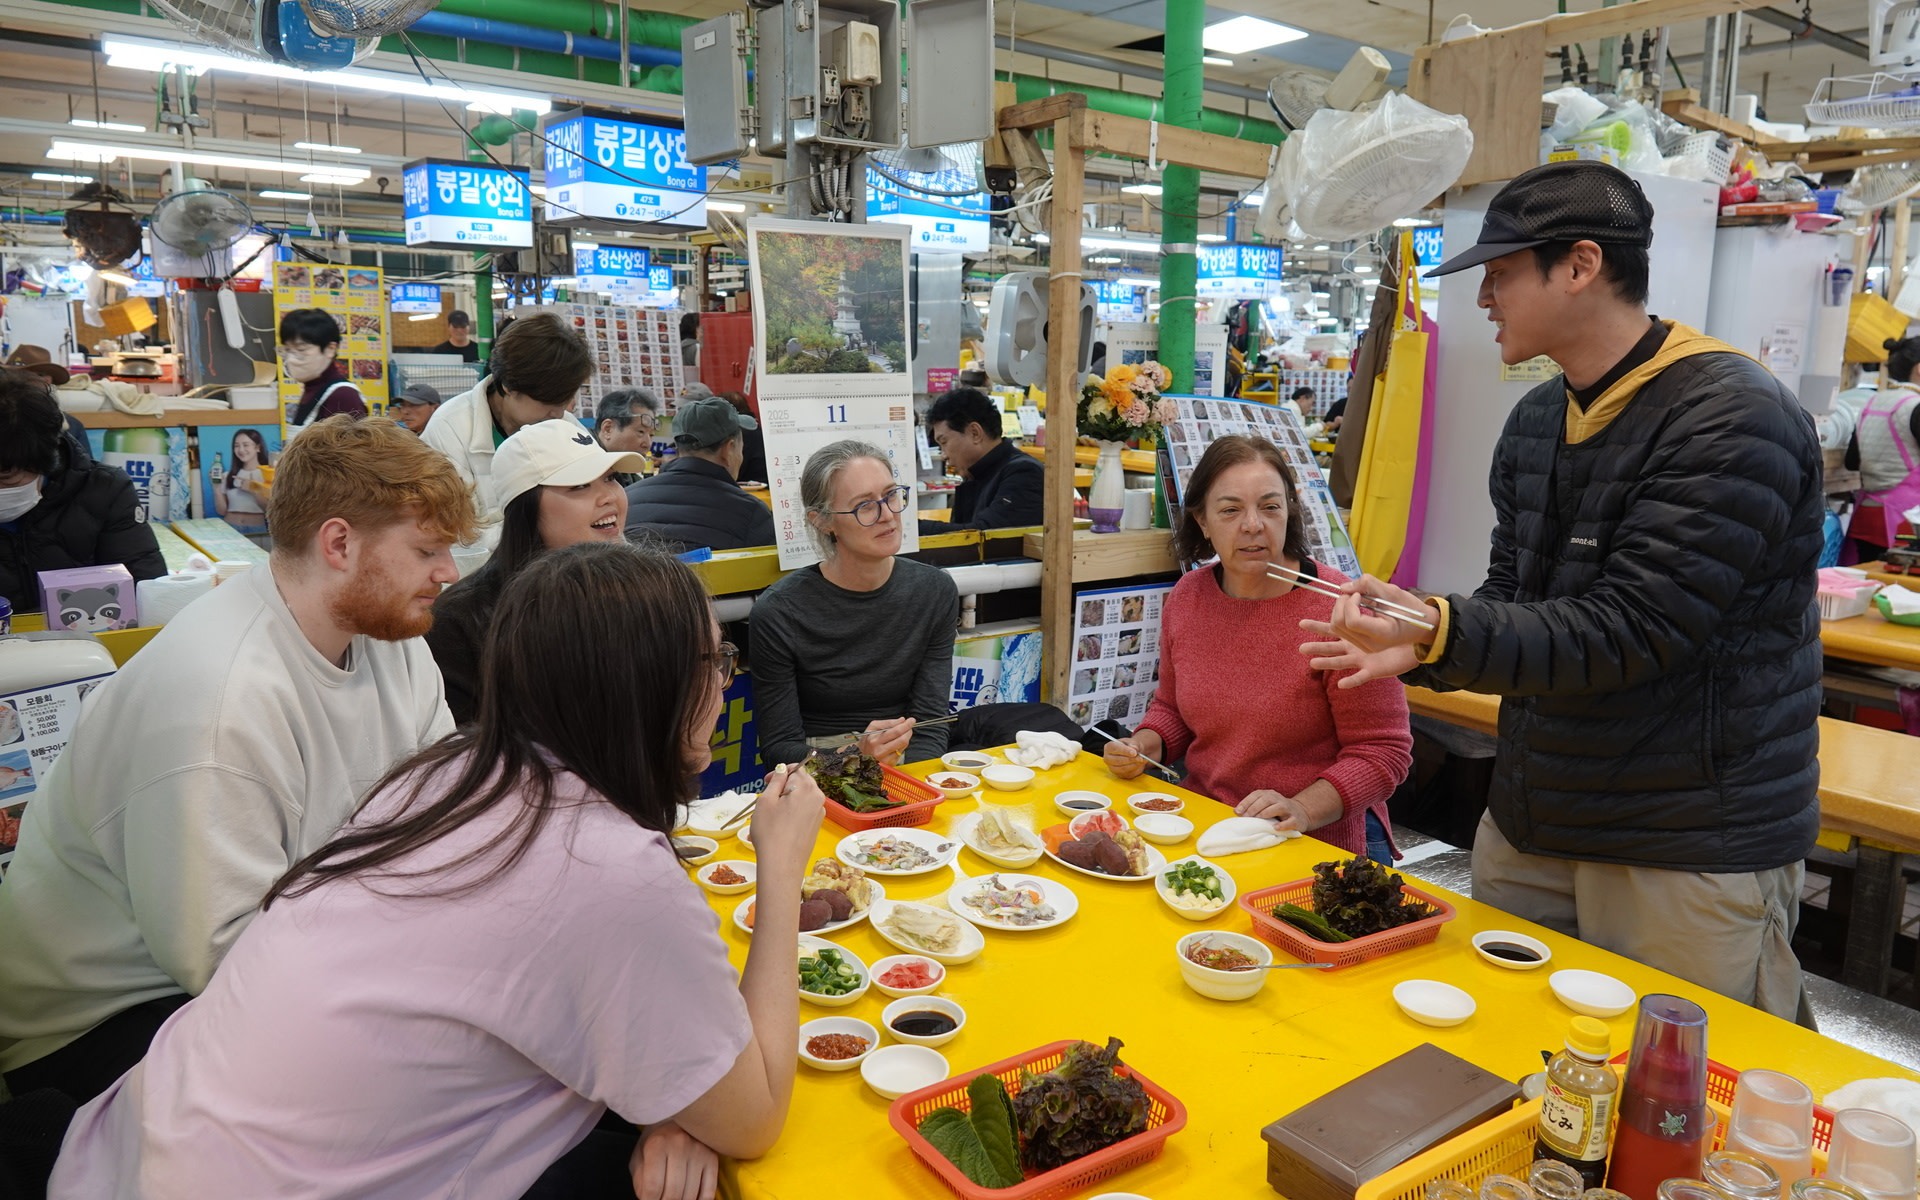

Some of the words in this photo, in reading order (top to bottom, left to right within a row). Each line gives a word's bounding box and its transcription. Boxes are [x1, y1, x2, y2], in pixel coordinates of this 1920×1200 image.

[593, 122, 698, 176] 봉길상회
[667, 176, 686, 188] Bong
[687, 177, 698, 188] Gil
[436, 169, 524, 208] 봉길상회
[497, 207, 514, 217] Bong
[629, 207, 678, 219] 247-0584
[467, 233, 508, 242] 247-0584
[932, 234, 968, 244] 247-0584
[597, 249, 646, 270] 경산상회
[649, 268, 669, 285] 상회
[768, 410, 789, 421] 2025
[827, 404, 848, 424] 11
[774, 457, 780, 466] 2
[795, 456, 800, 465] 3
[888, 450, 894, 459] 8
[777, 478, 783, 488] 9
[780, 500, 790, 509] 16
[783, 521, 792, 530] 23
[784, 532, 794, 541] 30
[36, 714, 57, 724] 50,000
[38, 720, 58, 730] 70,000
[36, 727, 60, 736] 100,000
